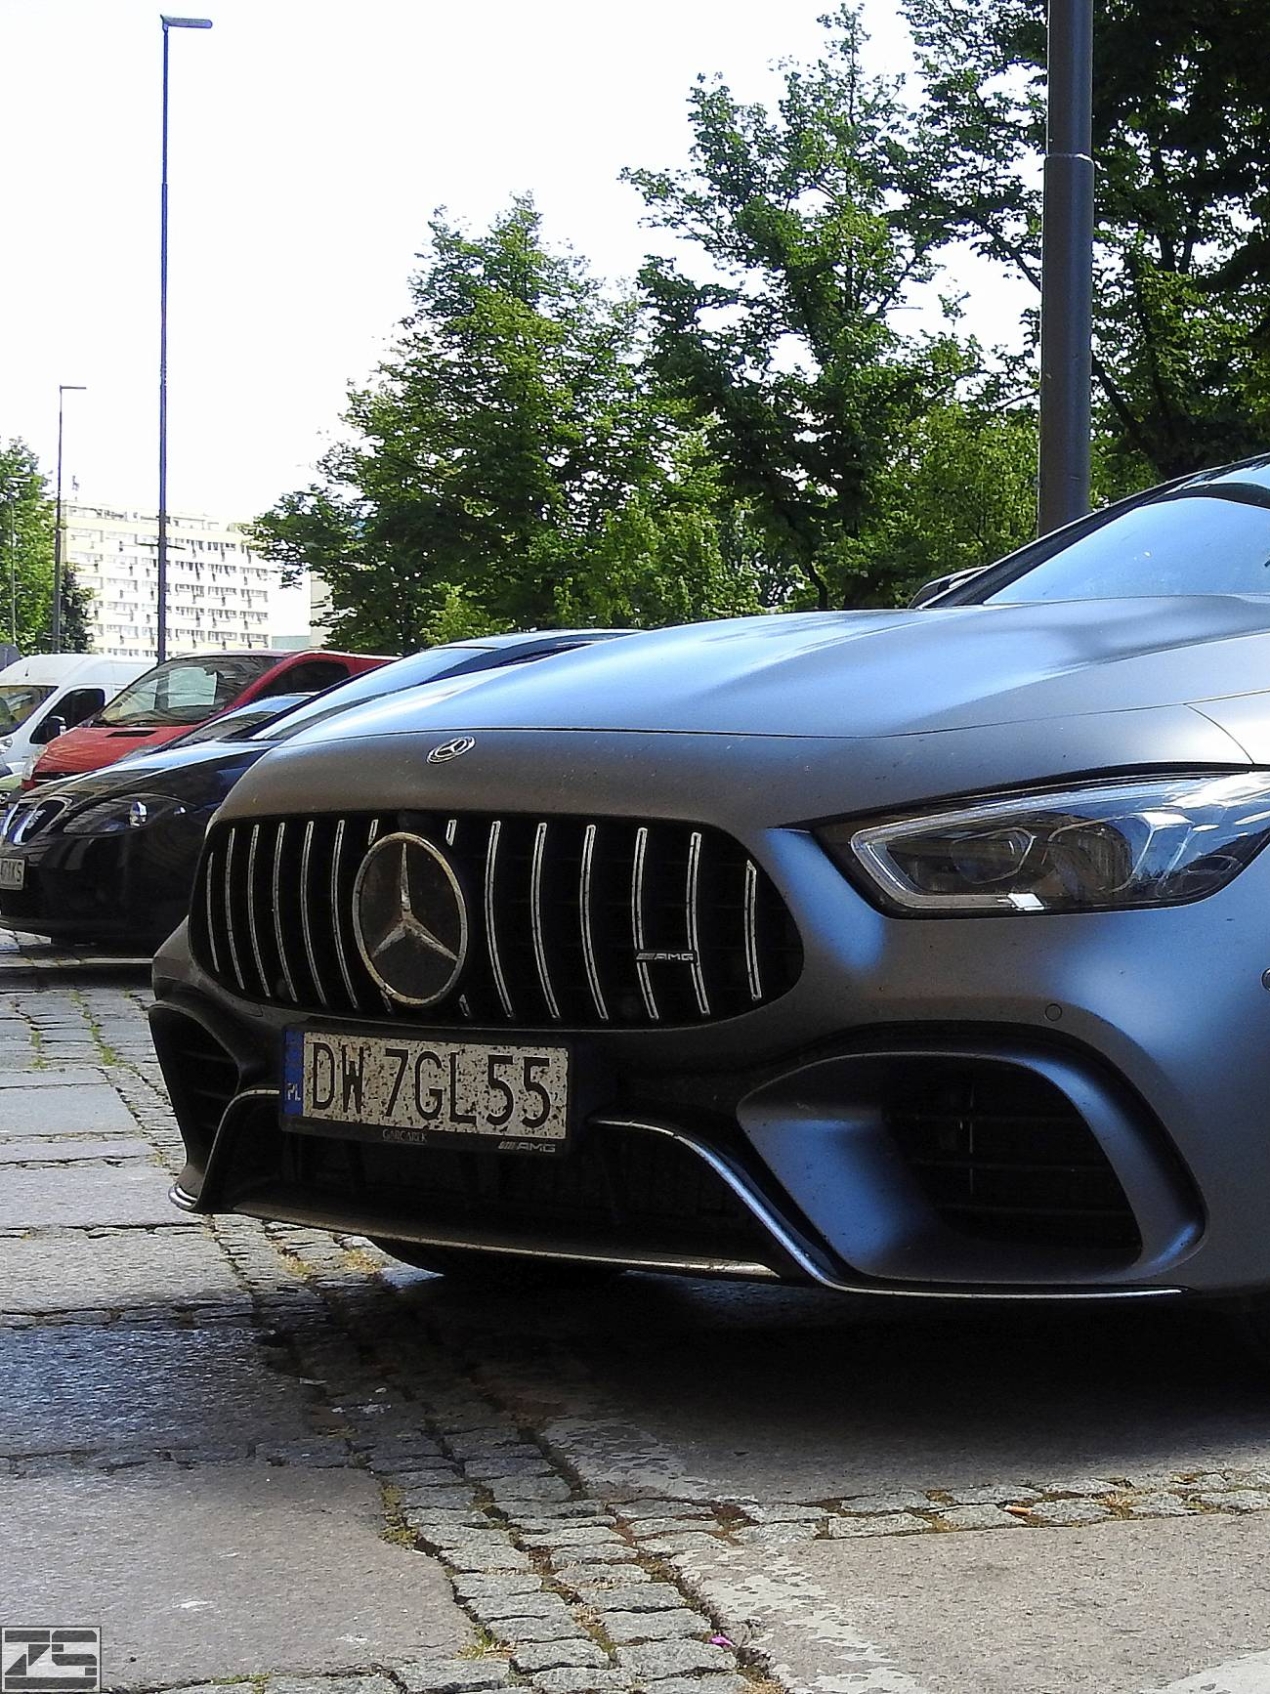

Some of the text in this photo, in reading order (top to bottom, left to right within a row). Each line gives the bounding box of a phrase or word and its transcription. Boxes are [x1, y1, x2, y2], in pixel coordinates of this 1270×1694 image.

[654, 953, 694, 961] AMG
[286, 1082, 302, 1101] PL
[311, 1041, 551, 1129] DW 7GL55
[516, 1142, 556, 1153] AMG
